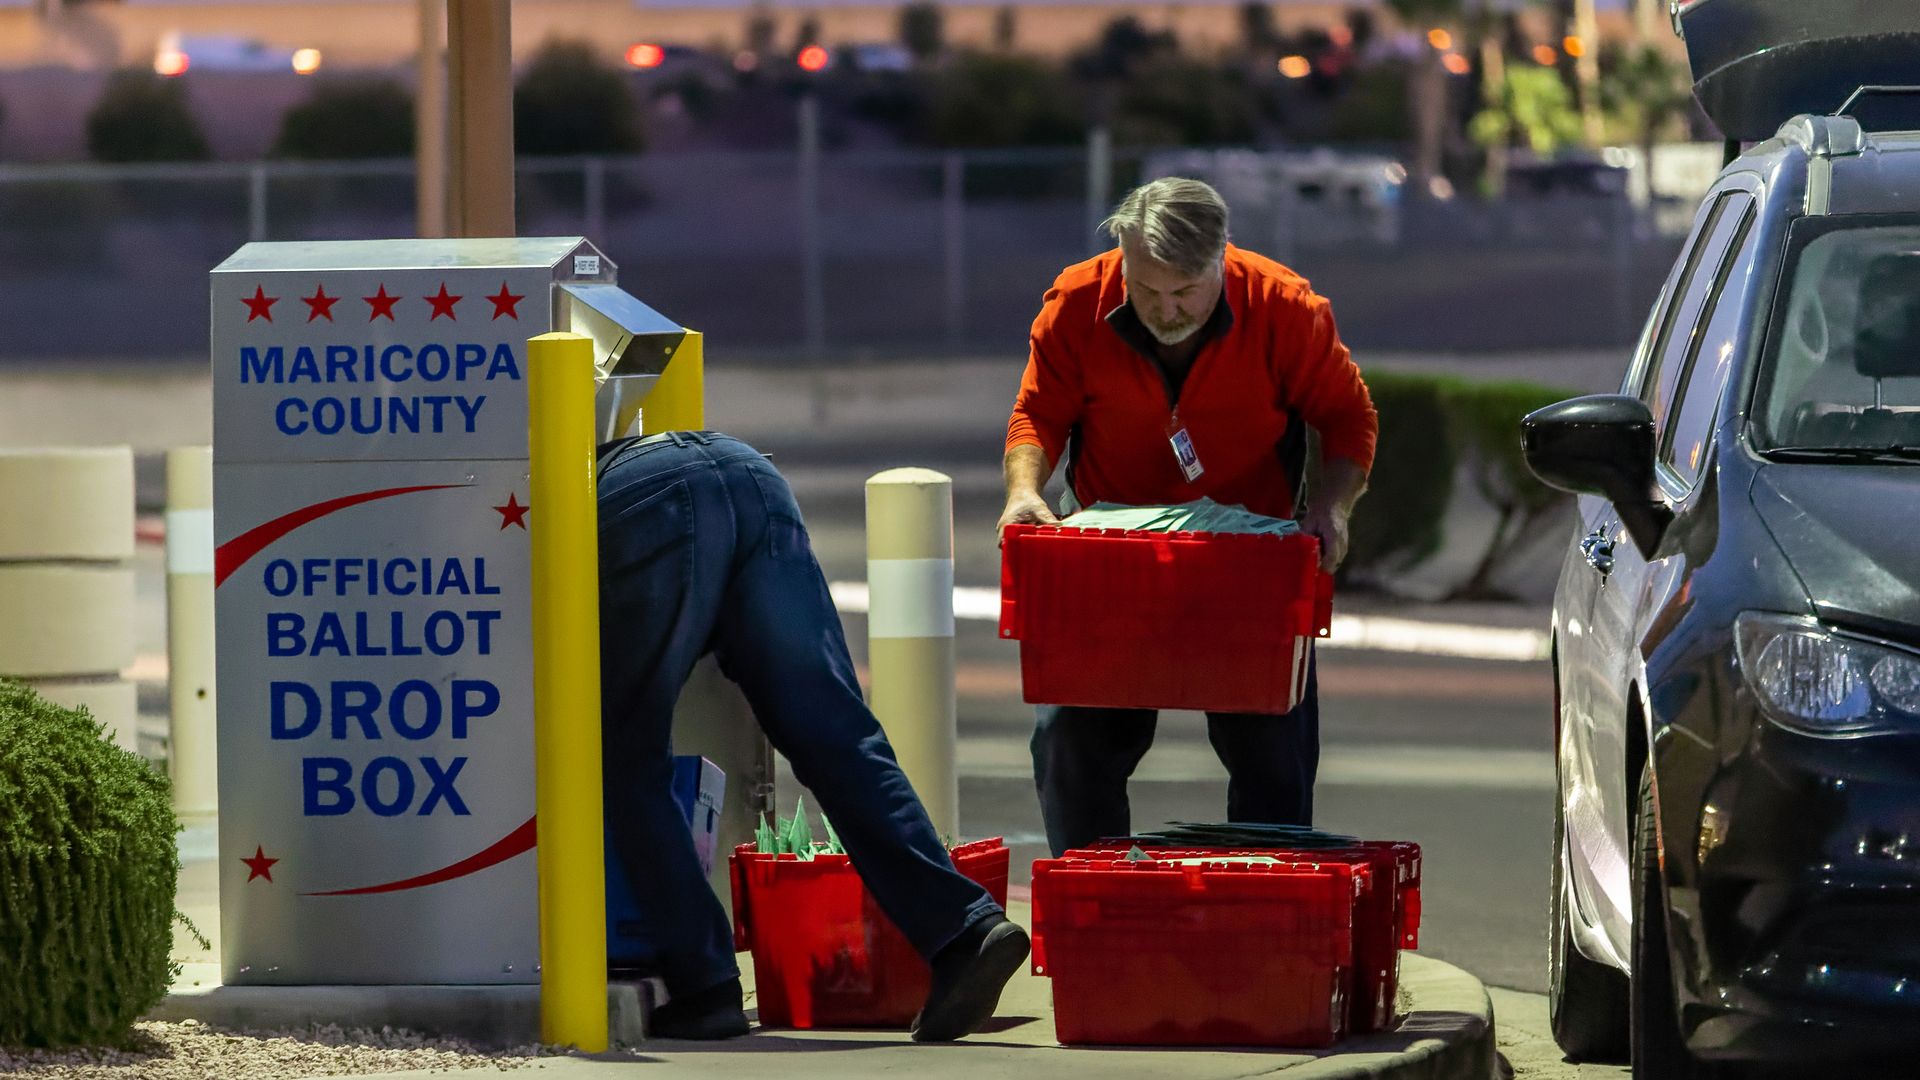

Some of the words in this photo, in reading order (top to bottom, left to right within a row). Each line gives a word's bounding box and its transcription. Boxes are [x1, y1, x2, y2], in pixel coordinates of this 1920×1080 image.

[240, 343, 521, 384] MARICOPA
[275, 395, 487, 436] COUNTY
[263, 557, 500, 597] OFFICIAL
[267, 611, 501, 657] BALLOT
[271, 679, 501, 740] DROP
[303, 756, 470, 817] BOX
